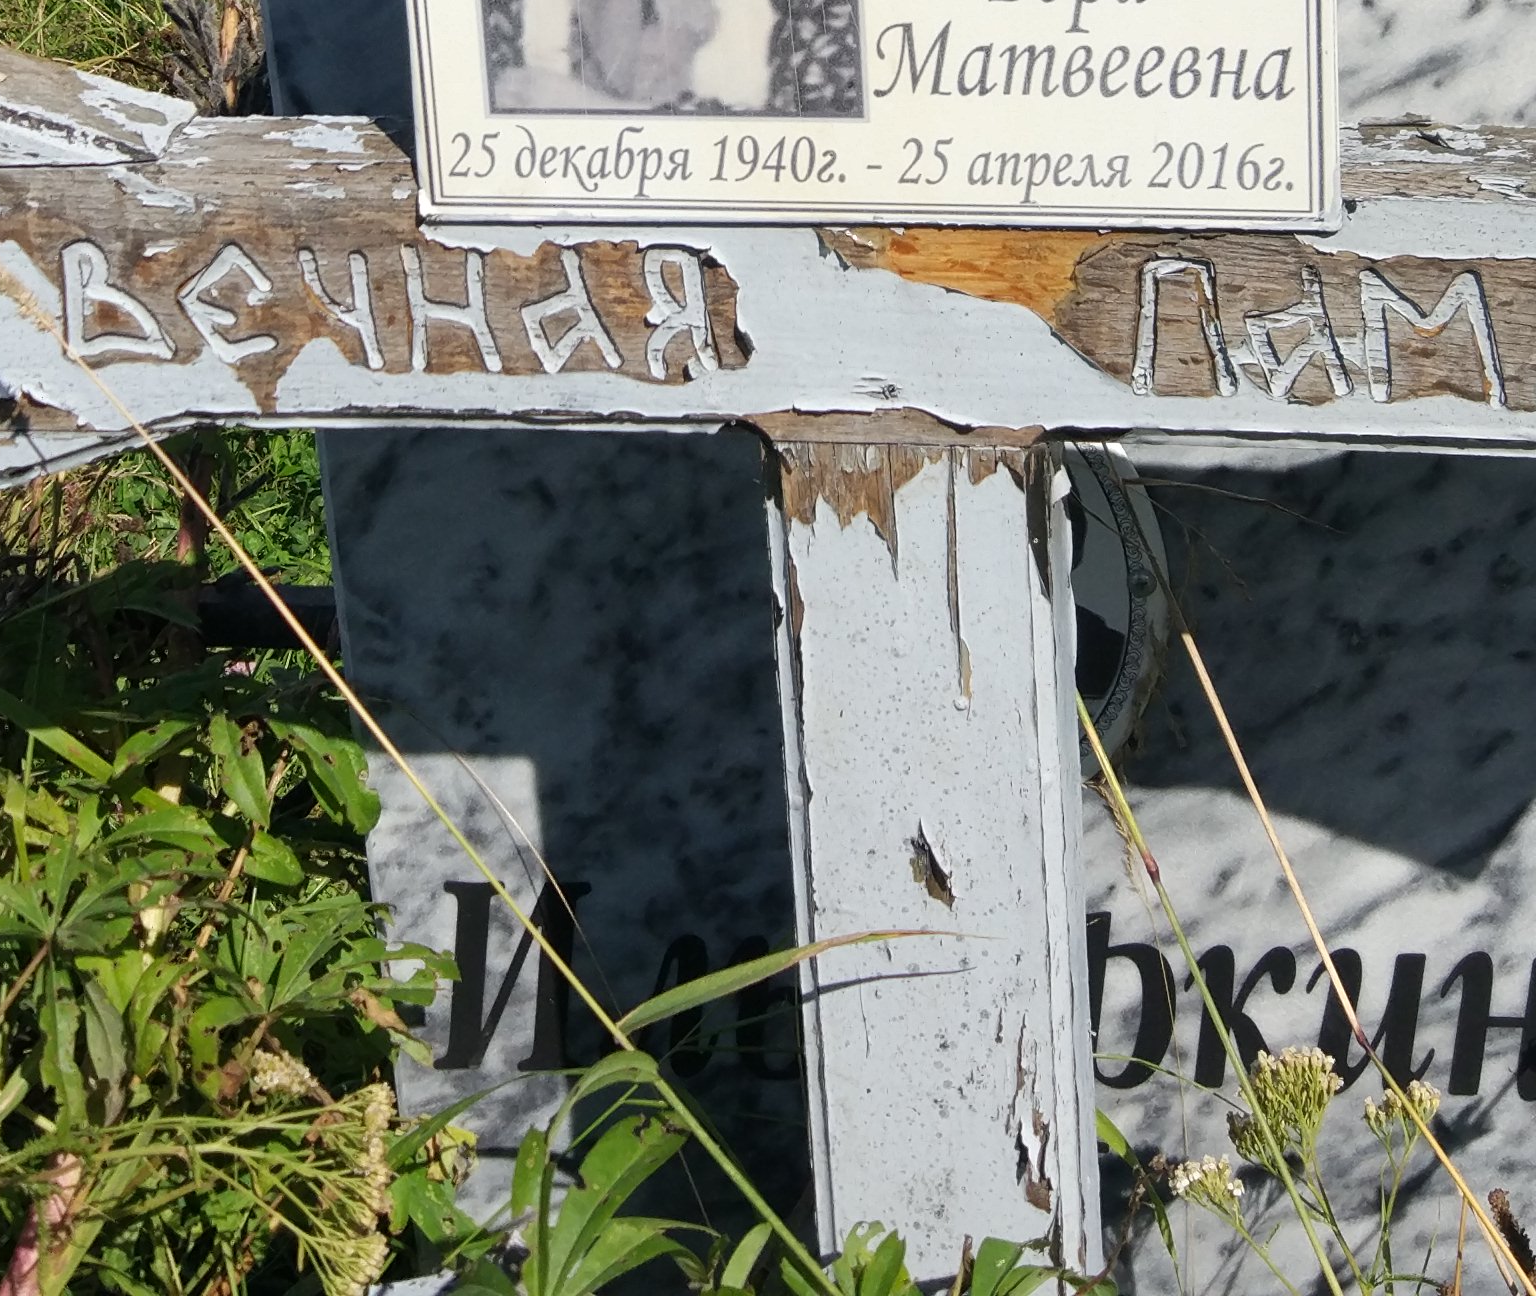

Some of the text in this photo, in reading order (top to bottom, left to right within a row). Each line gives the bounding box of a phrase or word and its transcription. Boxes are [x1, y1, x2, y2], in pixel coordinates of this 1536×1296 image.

[873, 21, 1295, 101] Матвеевна
[449, 132, 499, 179] 25
[511, 125, 694, 199] декабря
[709, 135, 847, 184] 1940г.
[898, 138, 953, 185] 25
[965, 151, 1133, 206] апреля
[1147, 141, 1295, 193] 2016г.
